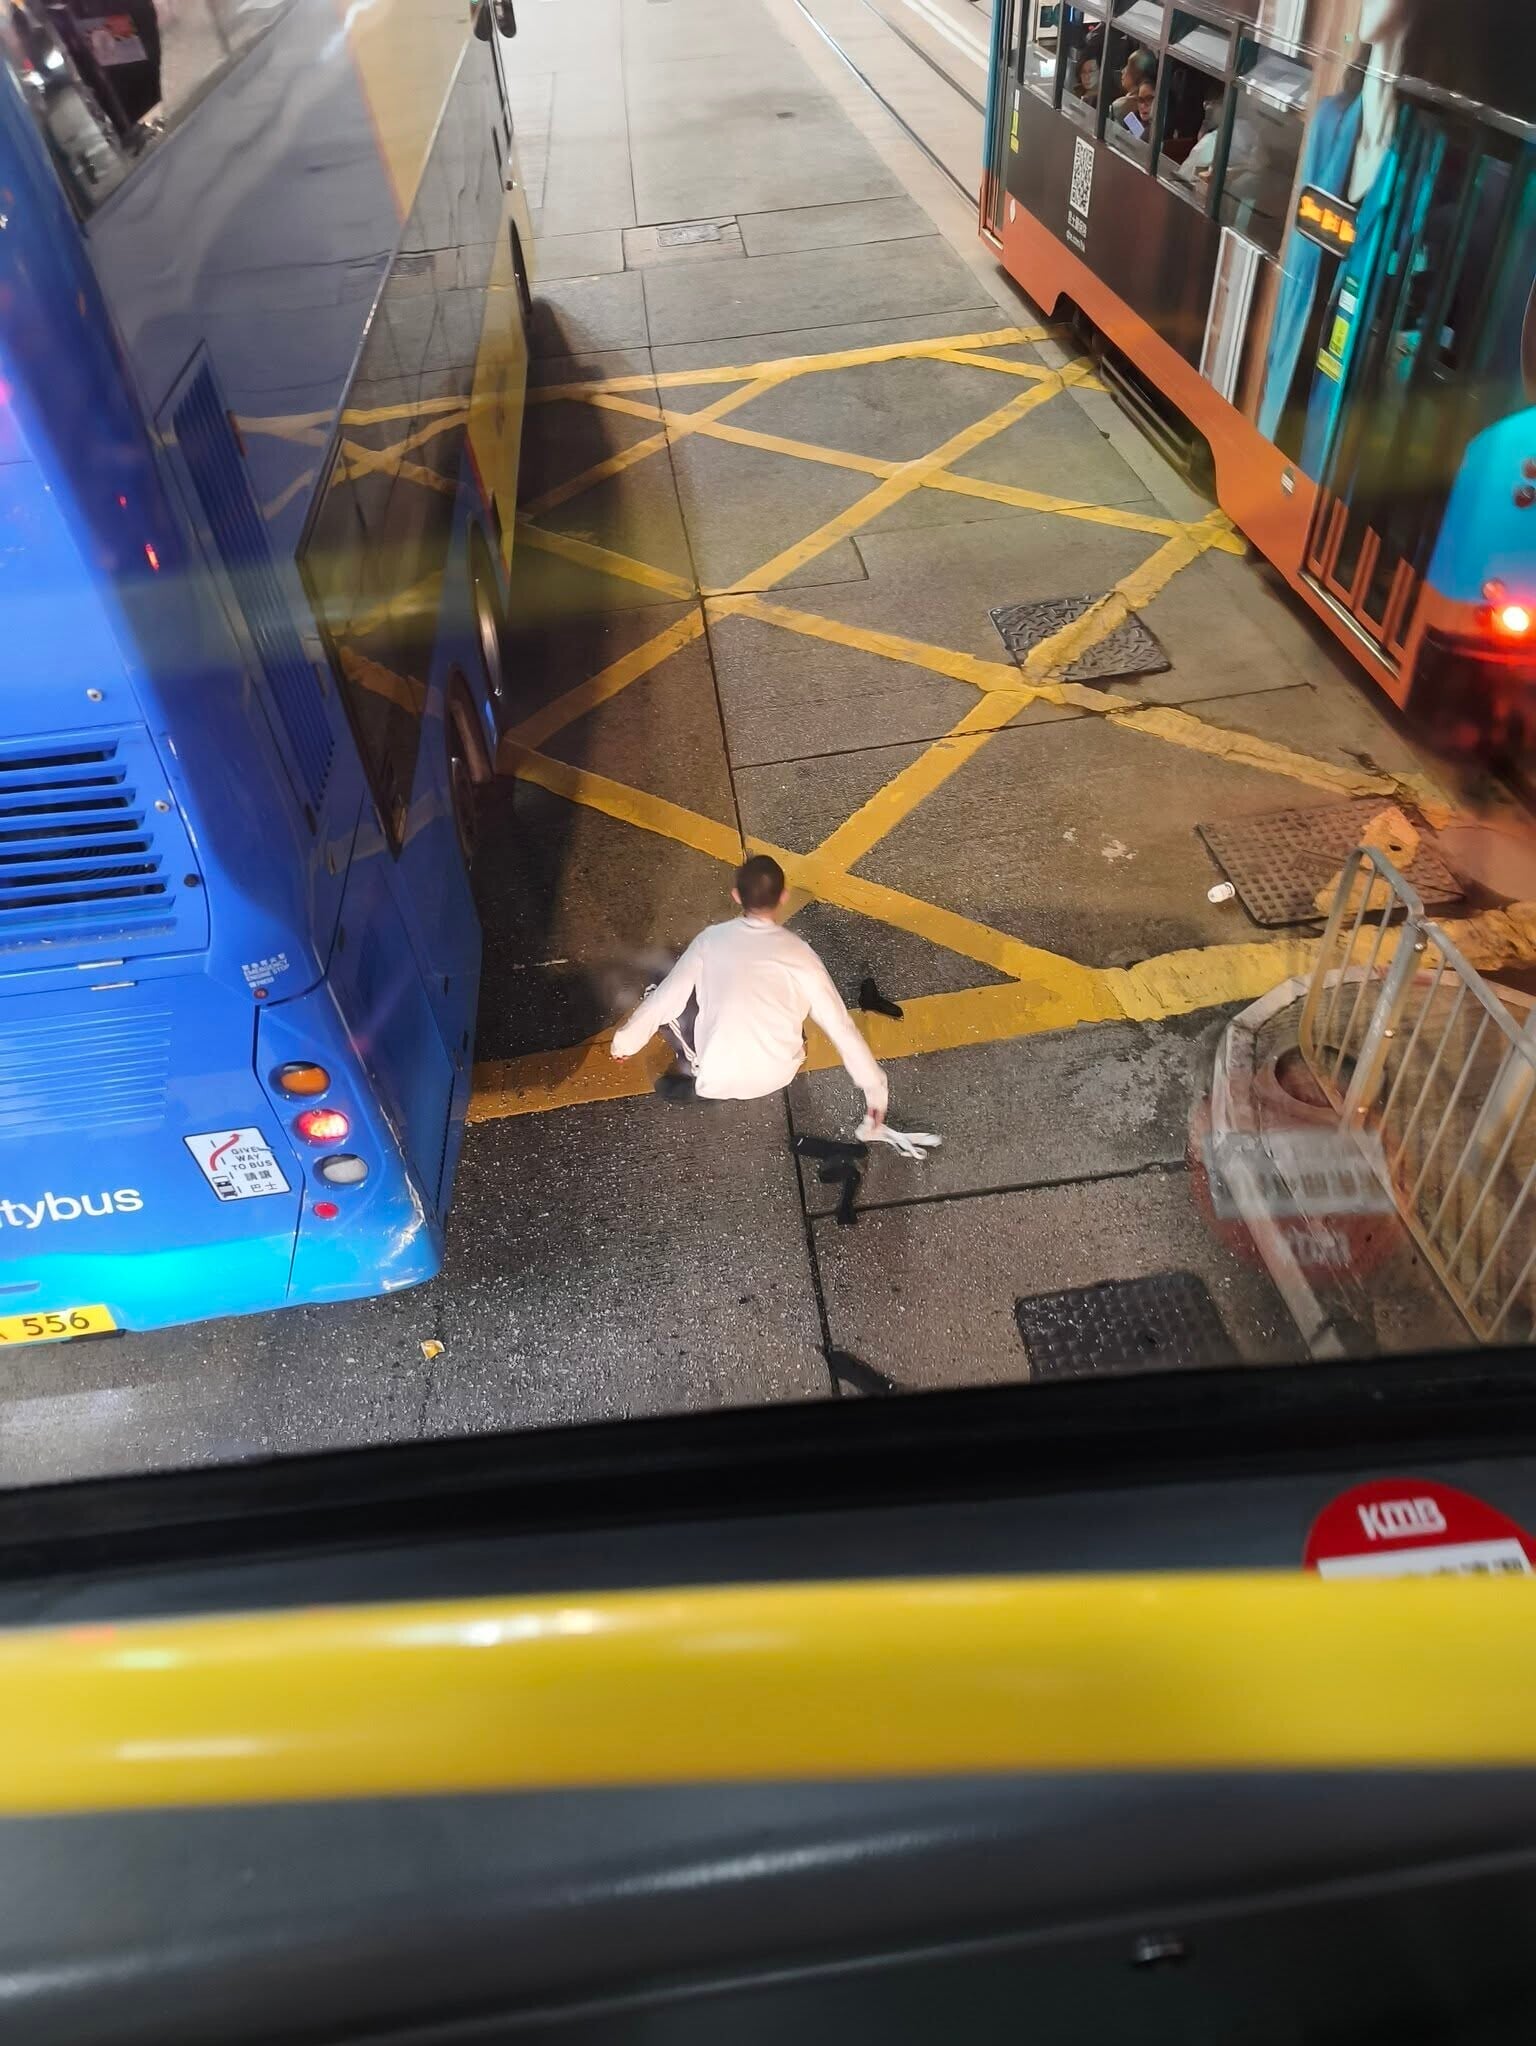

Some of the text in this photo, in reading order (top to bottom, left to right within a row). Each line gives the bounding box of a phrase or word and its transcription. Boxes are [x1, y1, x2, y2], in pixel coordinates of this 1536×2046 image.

[231, 1146, 258, 1155] GIVE
[236, 1153, 260, 1162] WAY
[250, 1160, 273, 1168] BUS
[251, 1182, 278, 1193] 巴士
[0, 1189, 144, 1229] tybus
[22, 1312, 90, 1336] 556
[1357, 1496, 1447, 1541] KMB
